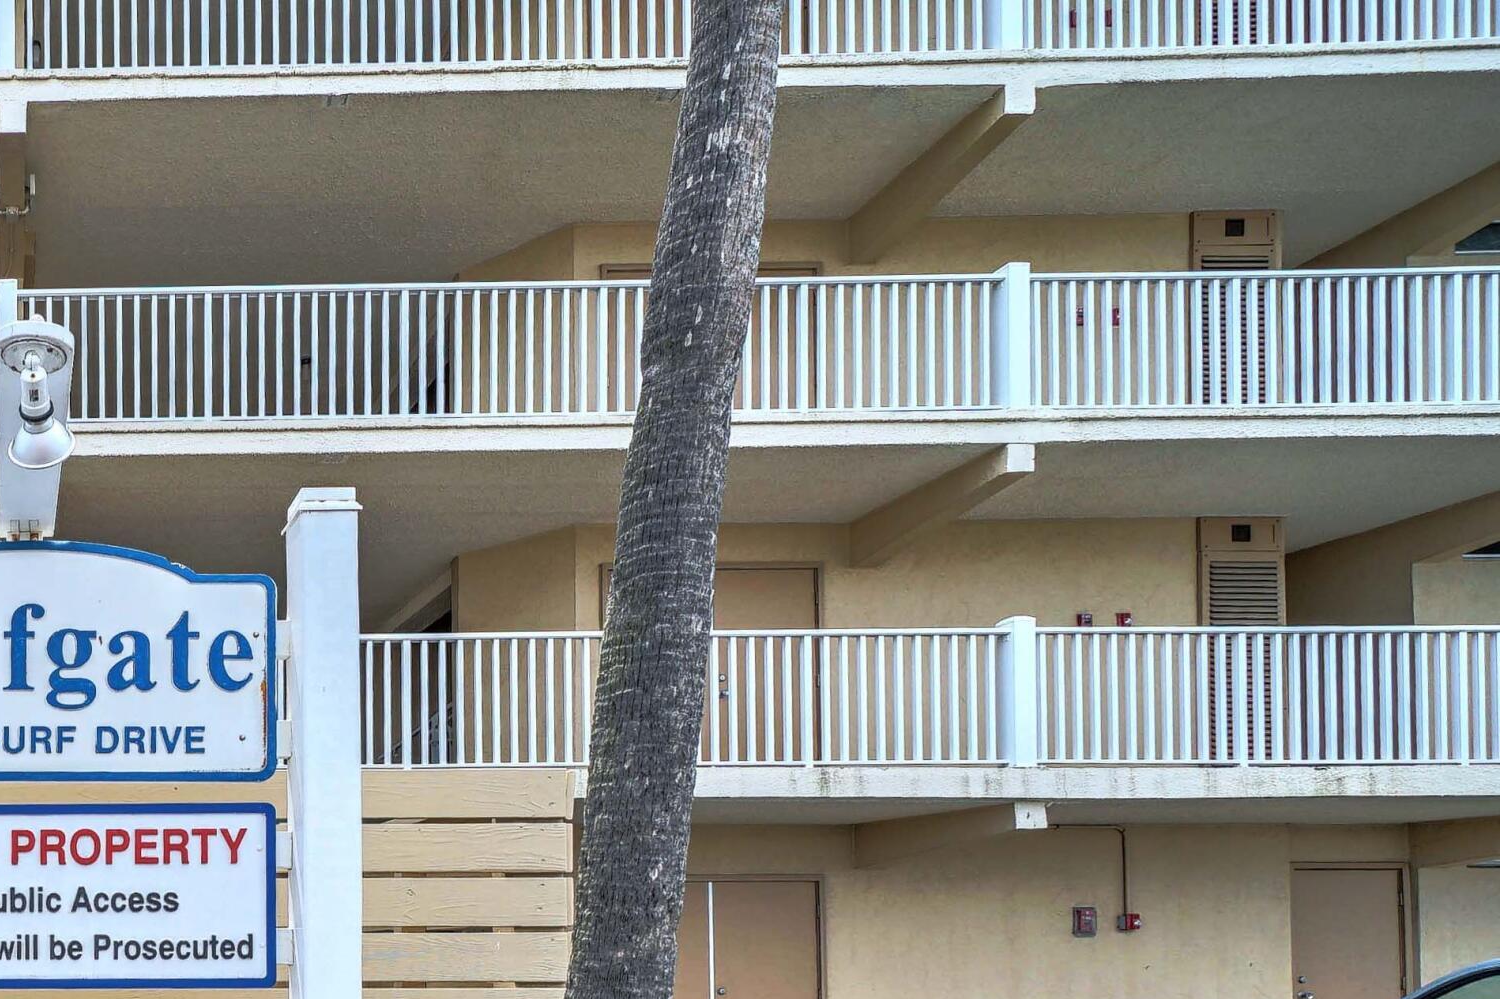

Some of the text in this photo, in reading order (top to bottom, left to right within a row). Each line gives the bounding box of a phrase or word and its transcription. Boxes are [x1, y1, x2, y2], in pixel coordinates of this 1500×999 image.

[95, 726, 205, 754] DRIVE
[11, 828, 247, 866] PROPERTY
[71, 887, 179, 913] Access
[50, 934, 83, 960] be
[94, 933, 253, 960] Prosecuted
